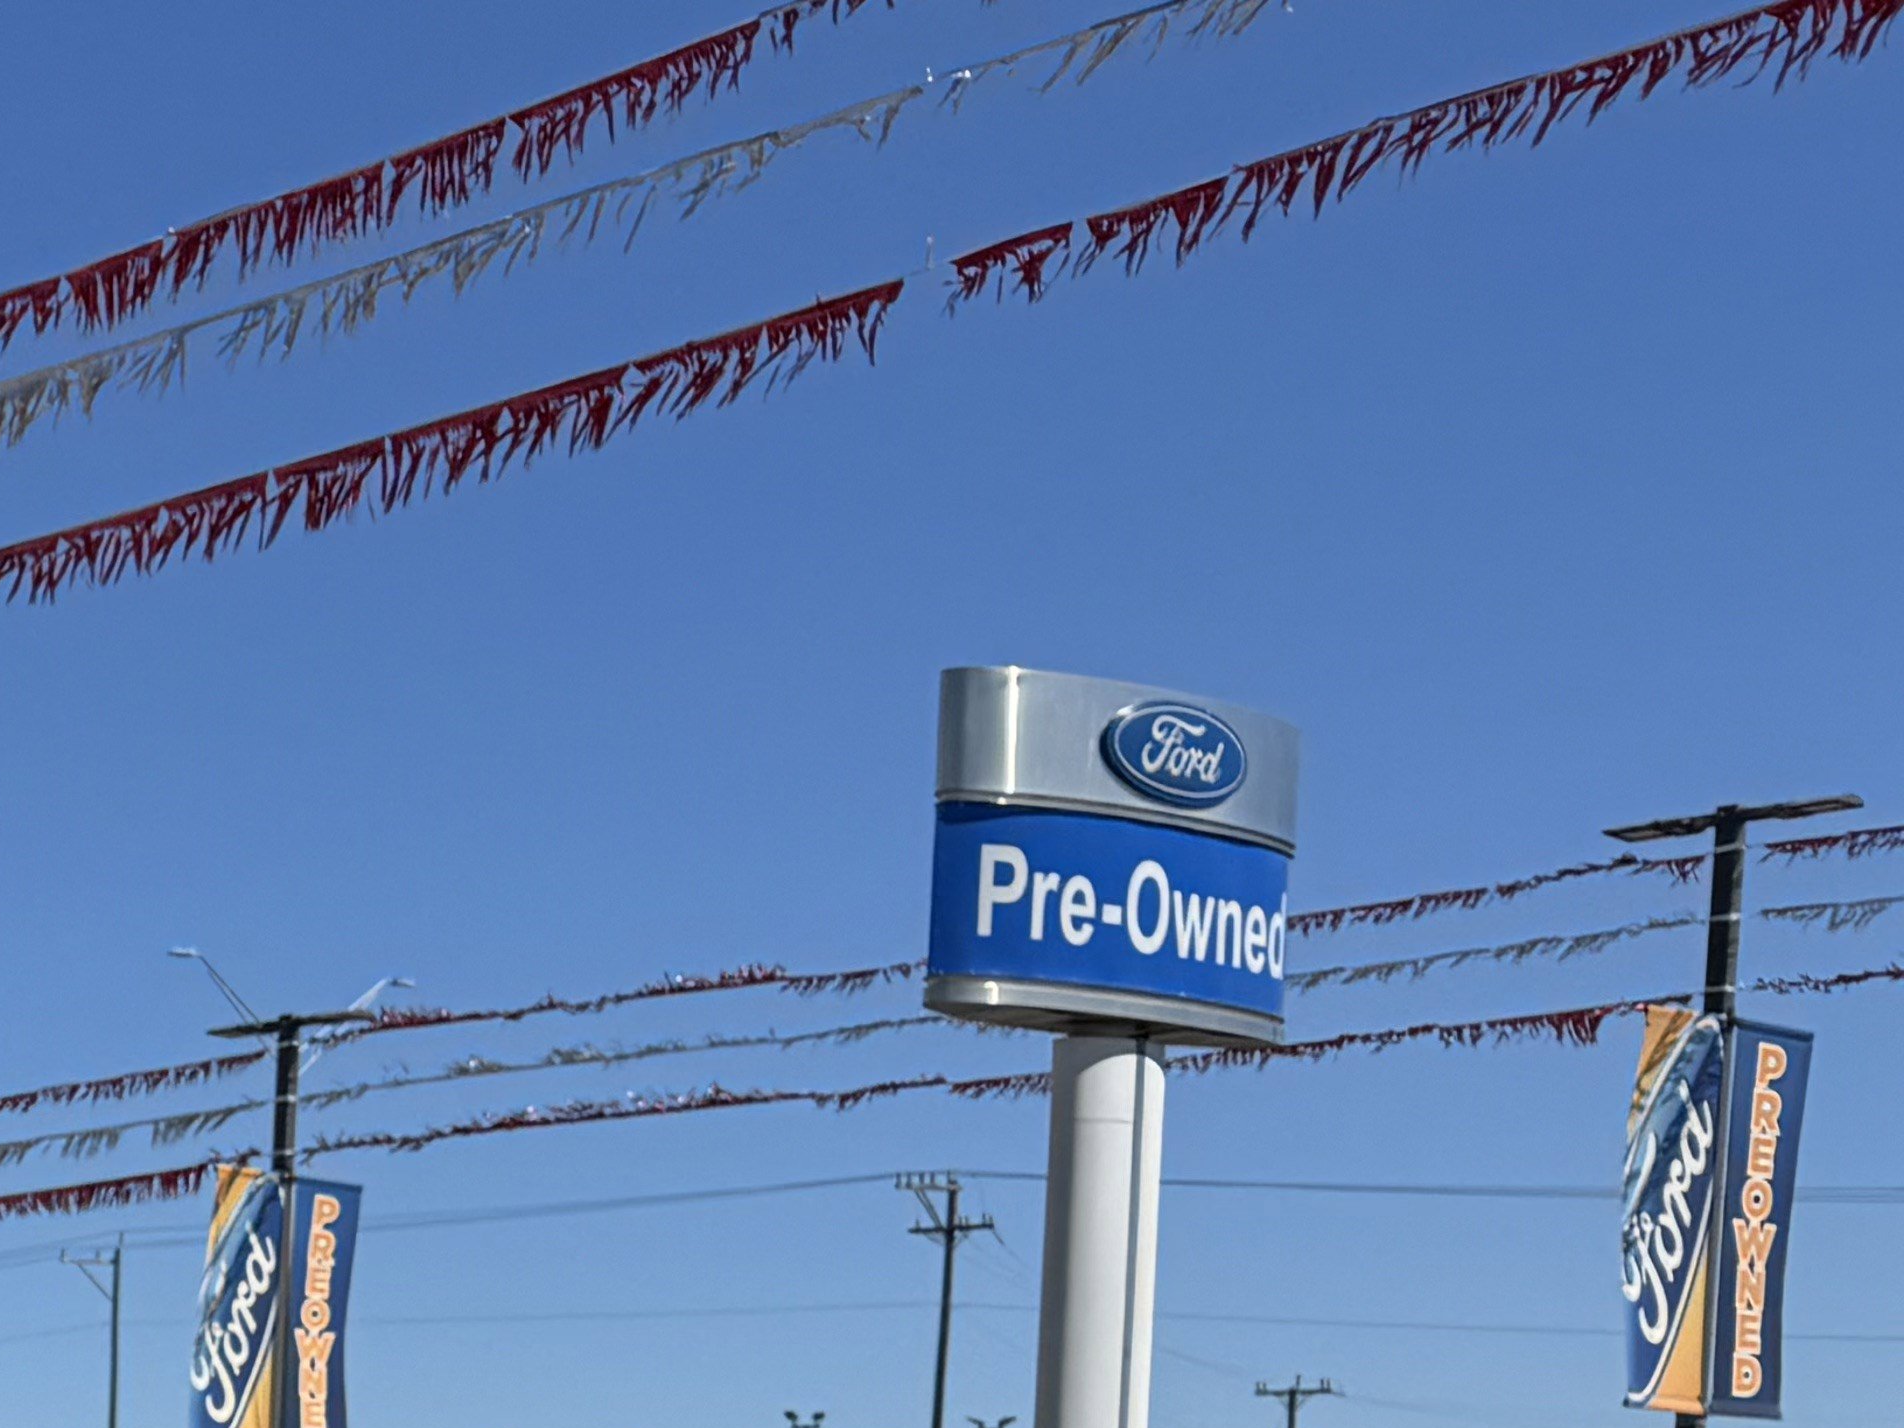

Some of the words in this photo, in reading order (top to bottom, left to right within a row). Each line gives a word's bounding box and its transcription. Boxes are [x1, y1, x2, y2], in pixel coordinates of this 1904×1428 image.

[1140, 713, 1226, 785] Ford
[976, 842, 1288, 980] Pre-Owned
[1620, 1080, 1715, 1345] Ford
[1730, 1041, 1788, 1398] PREOWNED
[189, 1218, 277, 1424] Ford
